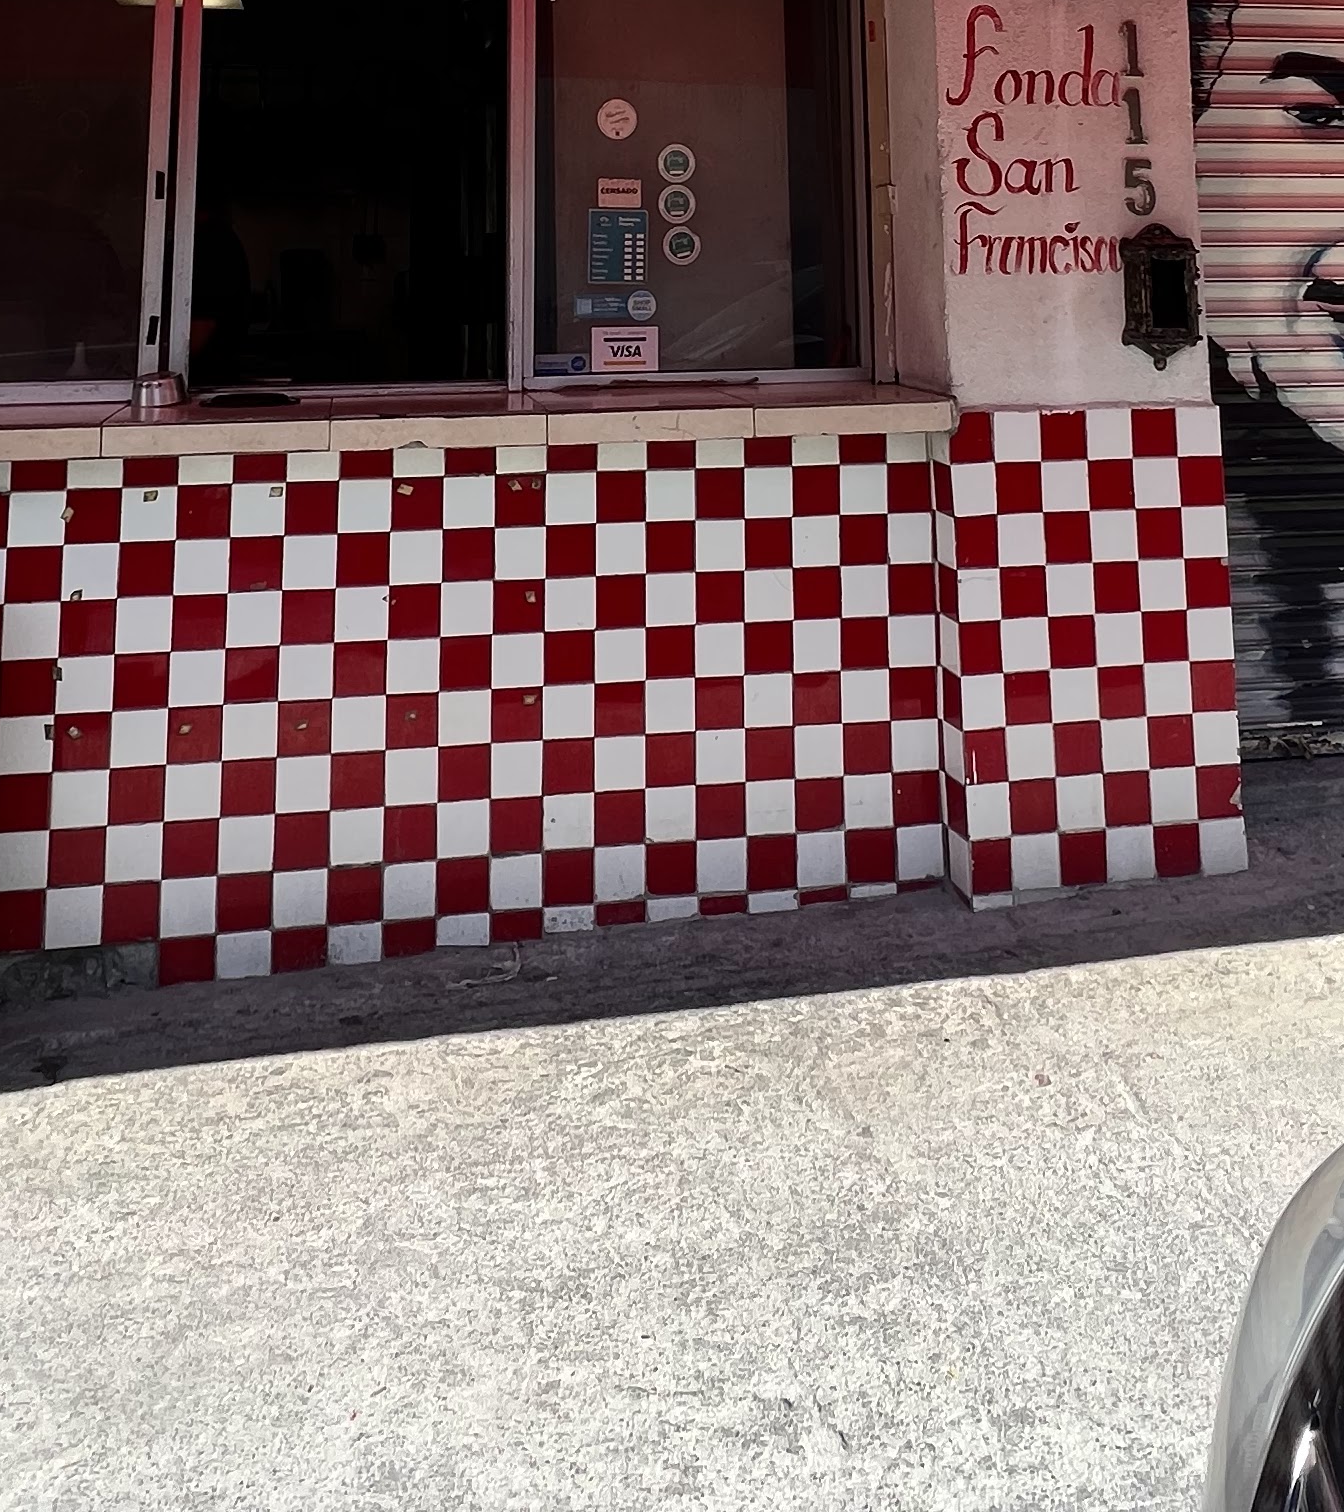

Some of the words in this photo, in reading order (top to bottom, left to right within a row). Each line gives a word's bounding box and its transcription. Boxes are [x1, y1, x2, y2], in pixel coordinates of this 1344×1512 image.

[946, 5, 1121, 107] Fonda
[952, 111, 1079, 196] San
[610, 345, 642, 358] VISA
